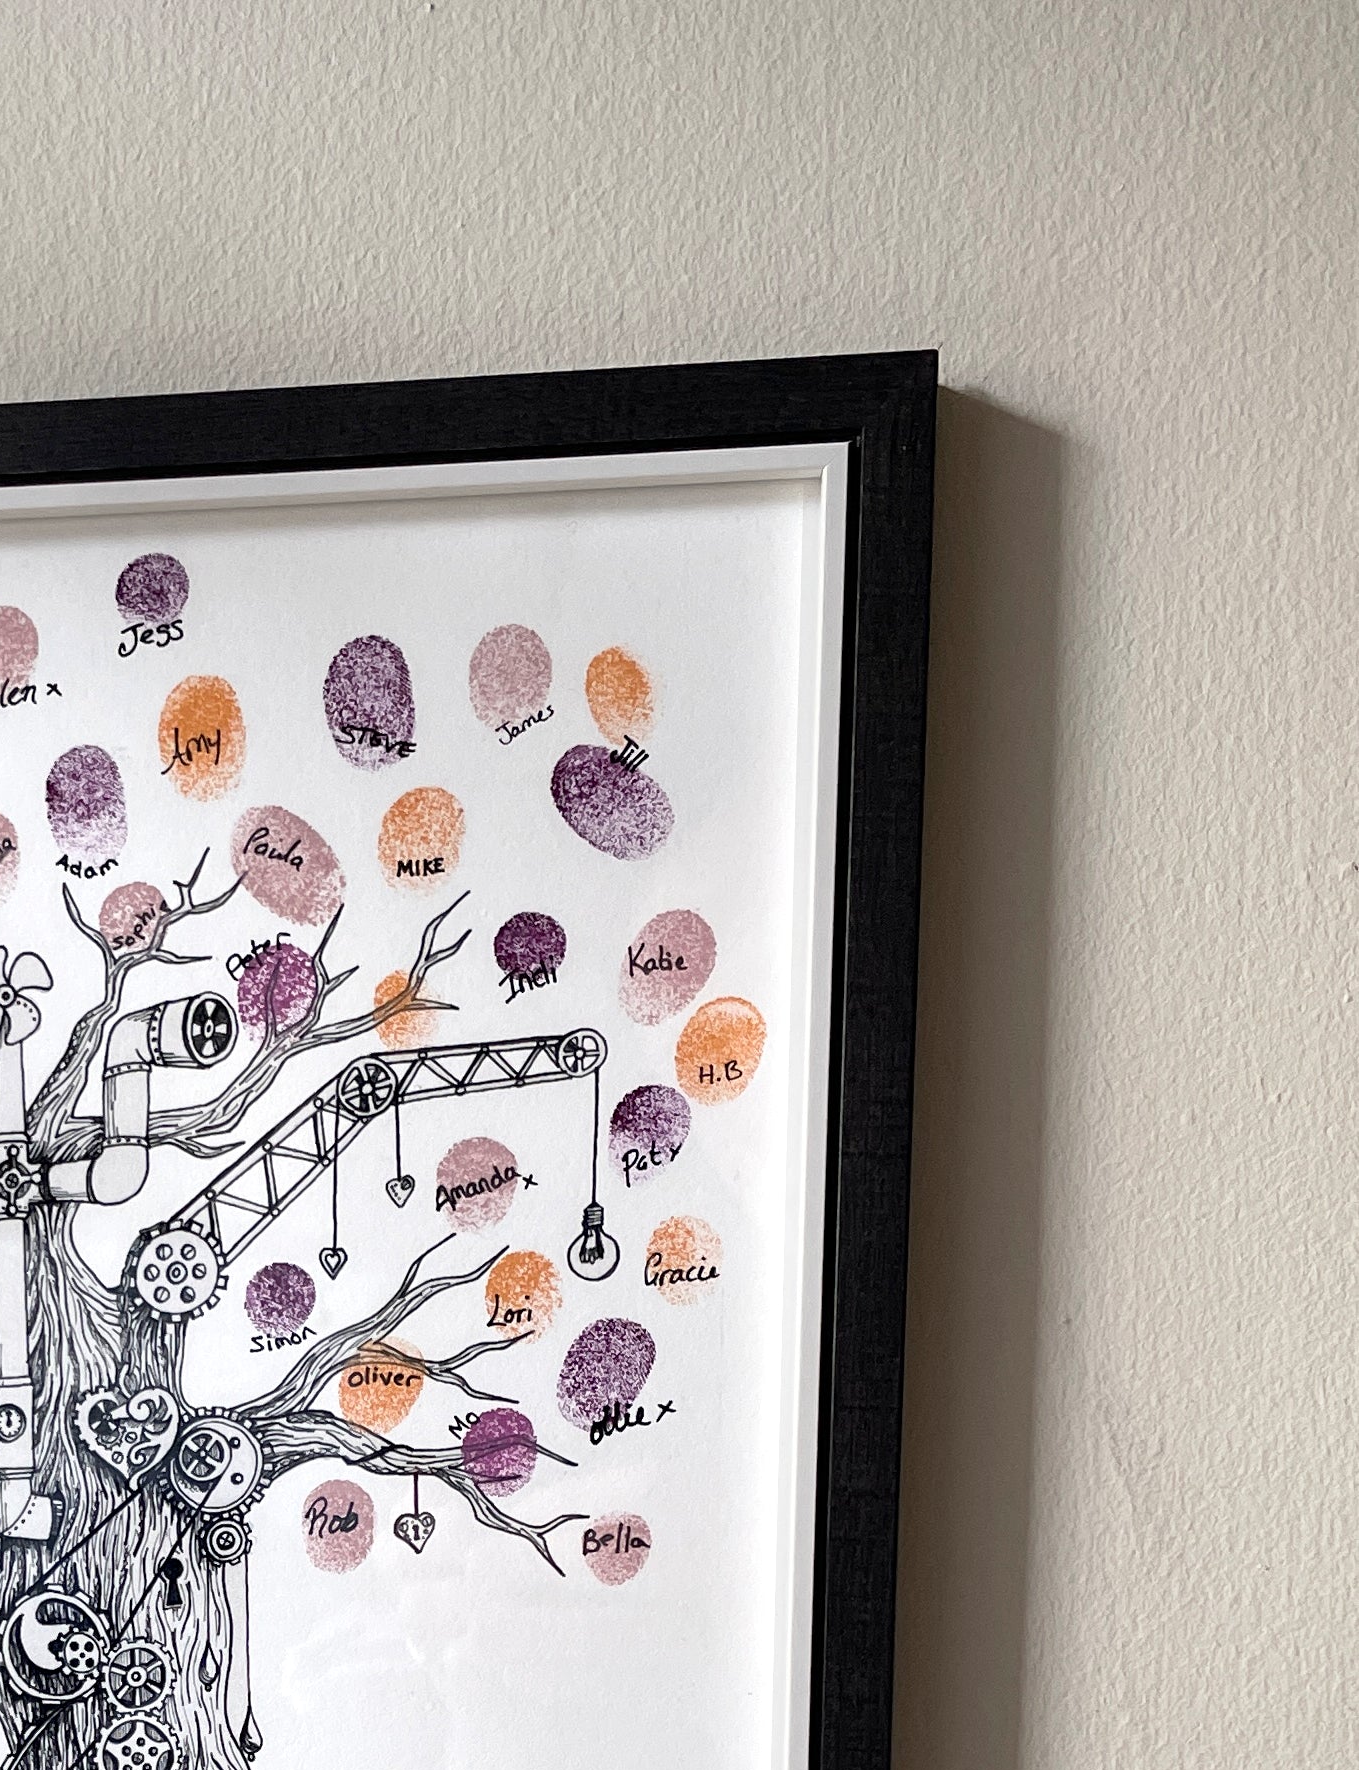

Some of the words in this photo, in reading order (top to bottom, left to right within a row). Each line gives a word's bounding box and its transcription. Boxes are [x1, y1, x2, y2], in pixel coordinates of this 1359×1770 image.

[117, 619, 184, 657] Jess
[498, 703, 555, 746] James
[161, 727, 222, 775] Amy
[242, 827, 305, 872] Paula
[396, 857, 445, 877] MIKE
[55, 855, 119, 880] Adam
[628, 942, 689, 977] Katie
[435, 1166, 521, 1212] Amanda
[486, 1293, 533, 1327] Lori
[249, 1326, 318, 1354] Simon
[448, 1410, 481, 1440] Mo
[304, 1496, 360, 1536] Rob
[582, 1527, 651, 1556] Bella
